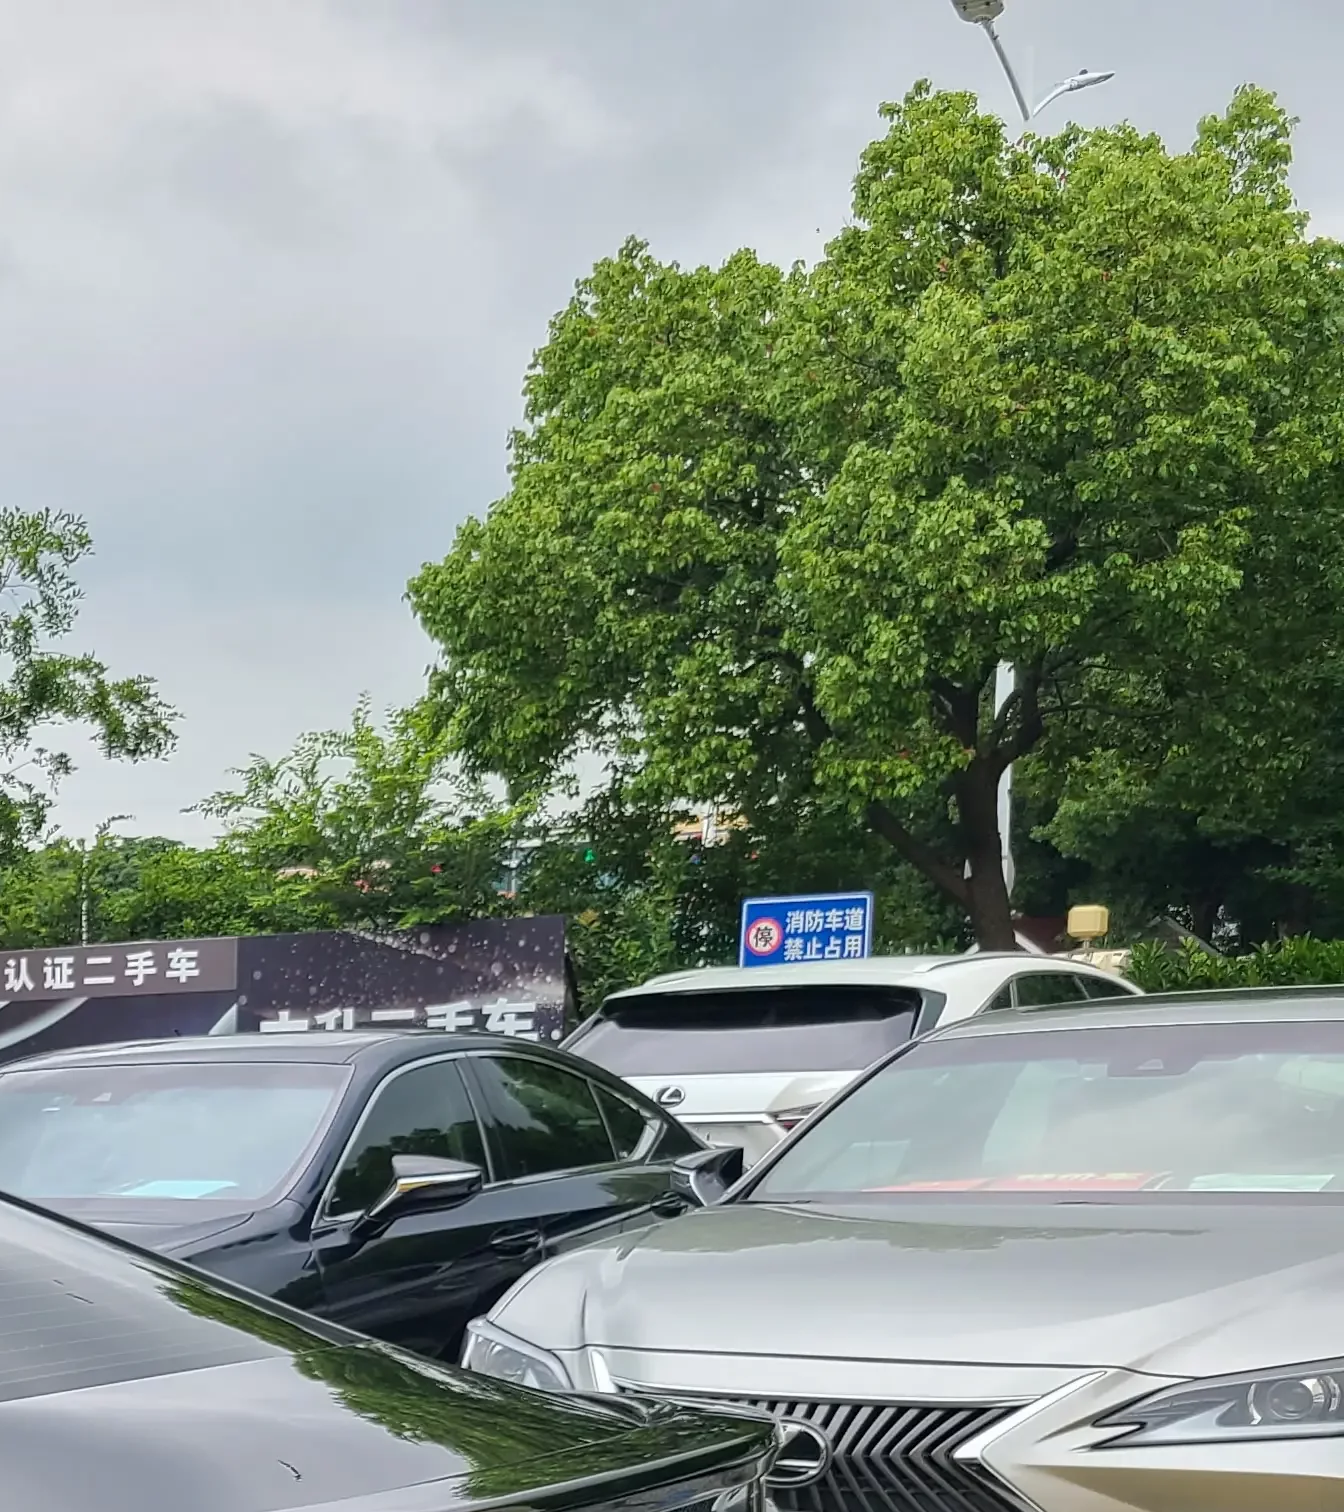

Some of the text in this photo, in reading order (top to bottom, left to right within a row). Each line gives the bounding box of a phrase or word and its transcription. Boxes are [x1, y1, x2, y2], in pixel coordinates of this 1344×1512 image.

[785, 907, 864, 934] 消防车道
[753, 926, 773, 948] 停
[783, 934, 862, 961] 禁止占用
